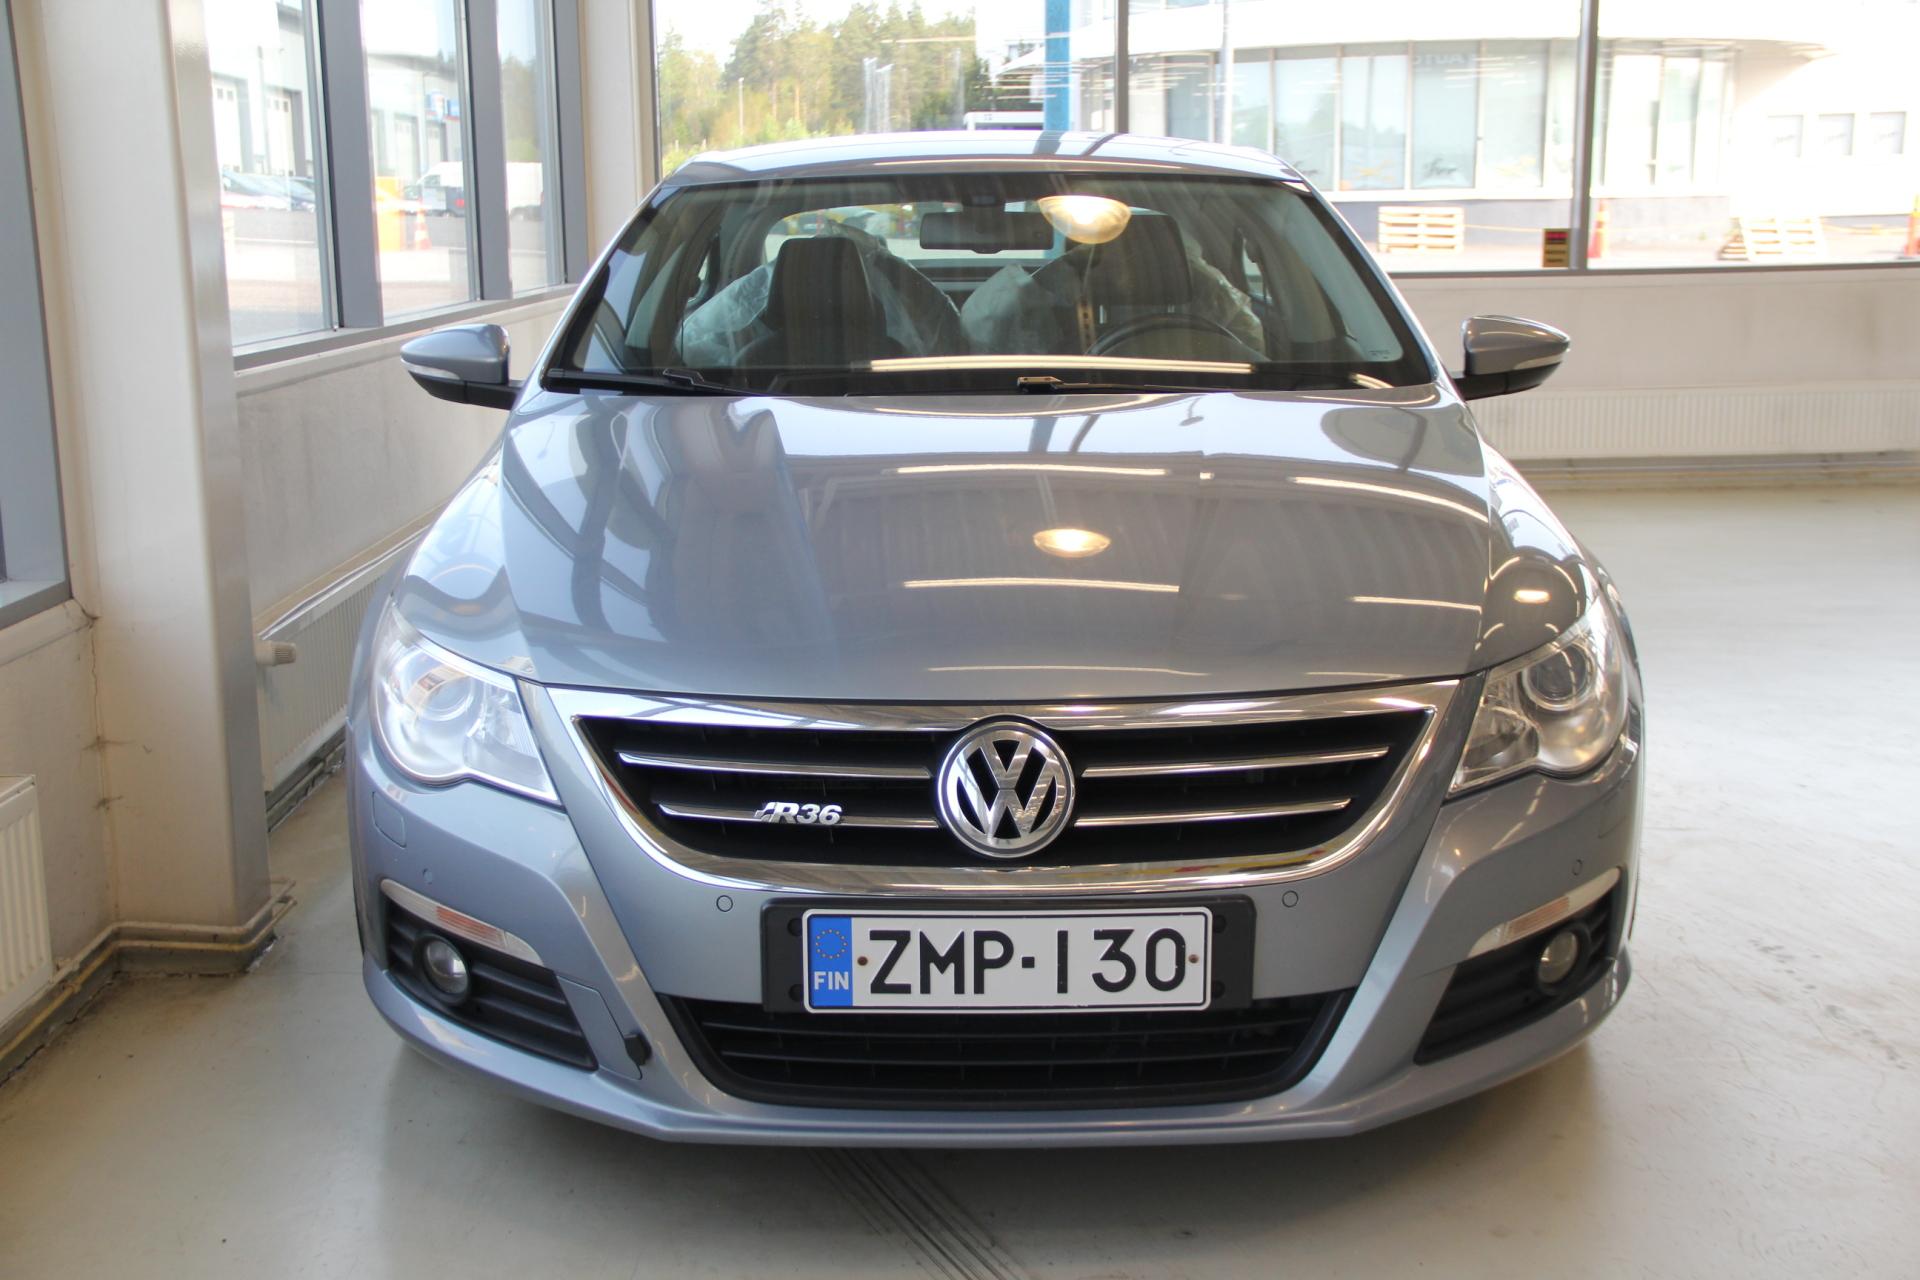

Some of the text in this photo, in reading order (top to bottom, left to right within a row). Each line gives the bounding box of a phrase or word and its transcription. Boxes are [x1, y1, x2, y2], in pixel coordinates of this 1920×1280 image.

[947, 730, 1067, 850] VW
[767, 802, 842, 825] R36
[814, 971, 850, 990] FIN
[868, 928, 1187, 995] ZMP-130
